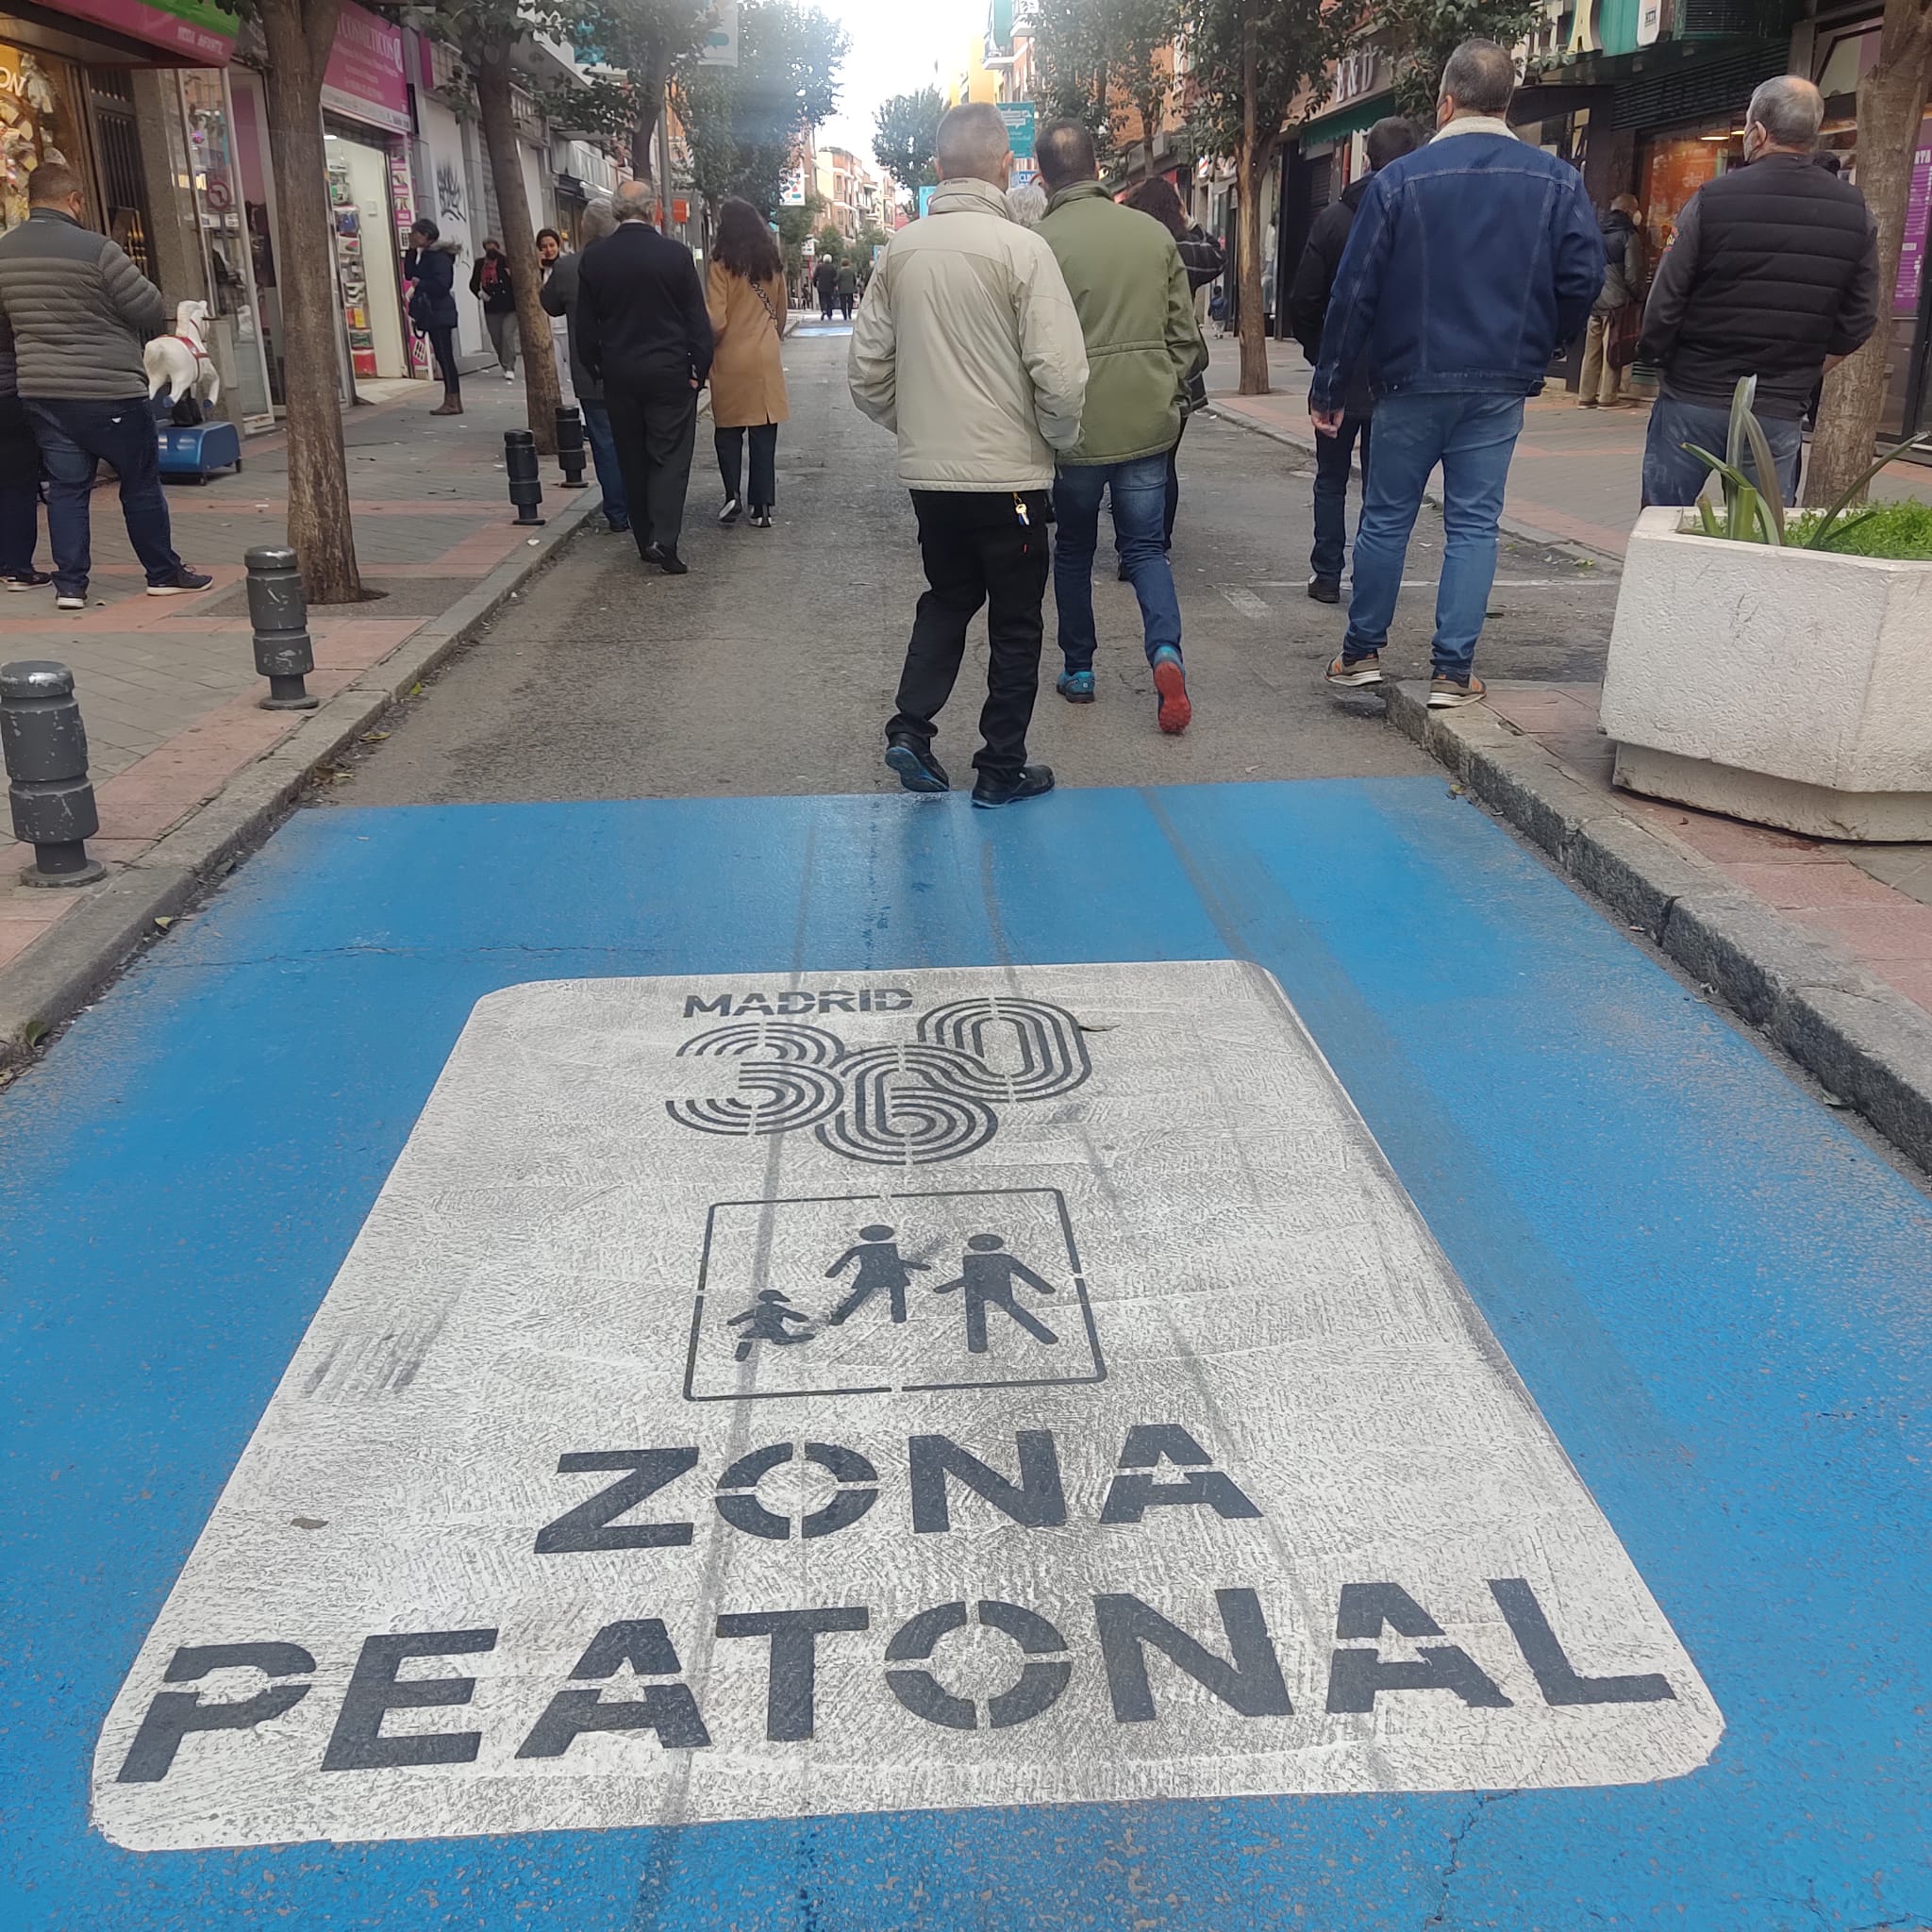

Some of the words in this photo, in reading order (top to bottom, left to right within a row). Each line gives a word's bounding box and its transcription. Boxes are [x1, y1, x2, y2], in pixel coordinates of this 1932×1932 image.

[683, 989, 913, 1018] MADRID
[666, 996, 1092, 1165] 360
[535, 1423, 1264, 1555] ZONA
[116, 1577, 1676, 1783] PEATONAL
